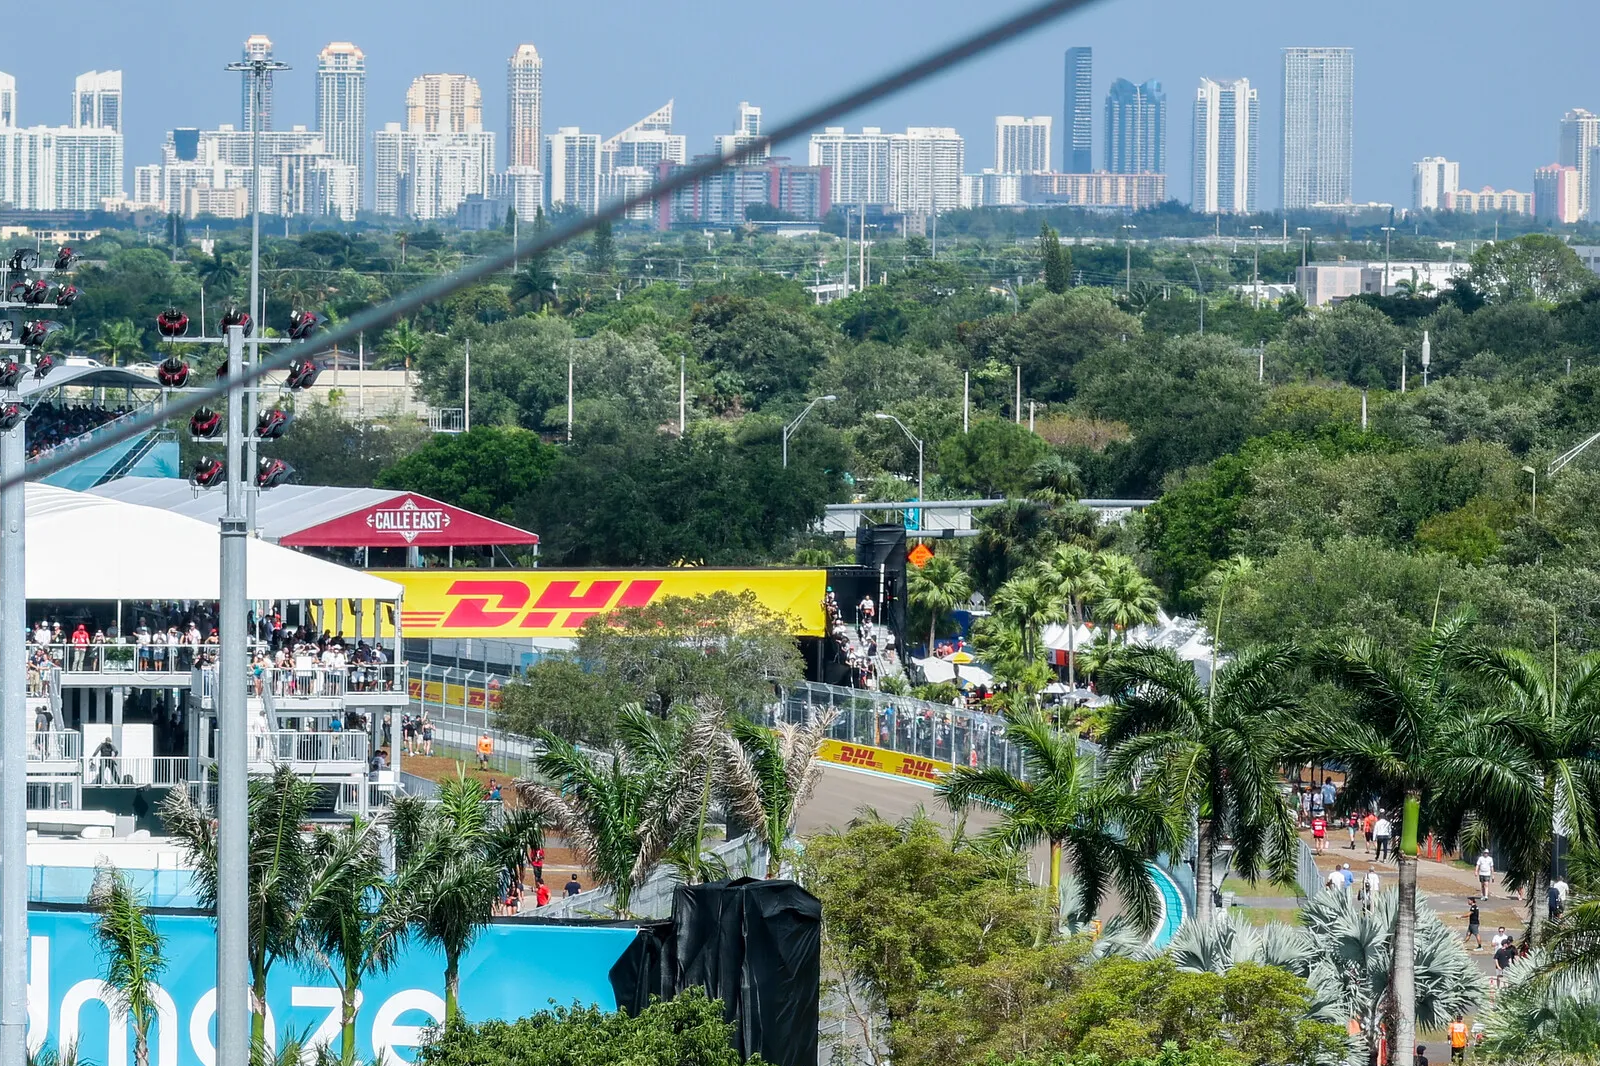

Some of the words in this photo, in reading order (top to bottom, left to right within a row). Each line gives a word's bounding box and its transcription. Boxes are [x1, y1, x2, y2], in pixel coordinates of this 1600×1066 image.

[375, 512, 410, 529] CALLE
[413, 512, 442, 529] EAST
[442, 579, 664, 628] DHL
[840, 745, 877, 767] DHL
[902, 758, 936, 780] DHL
